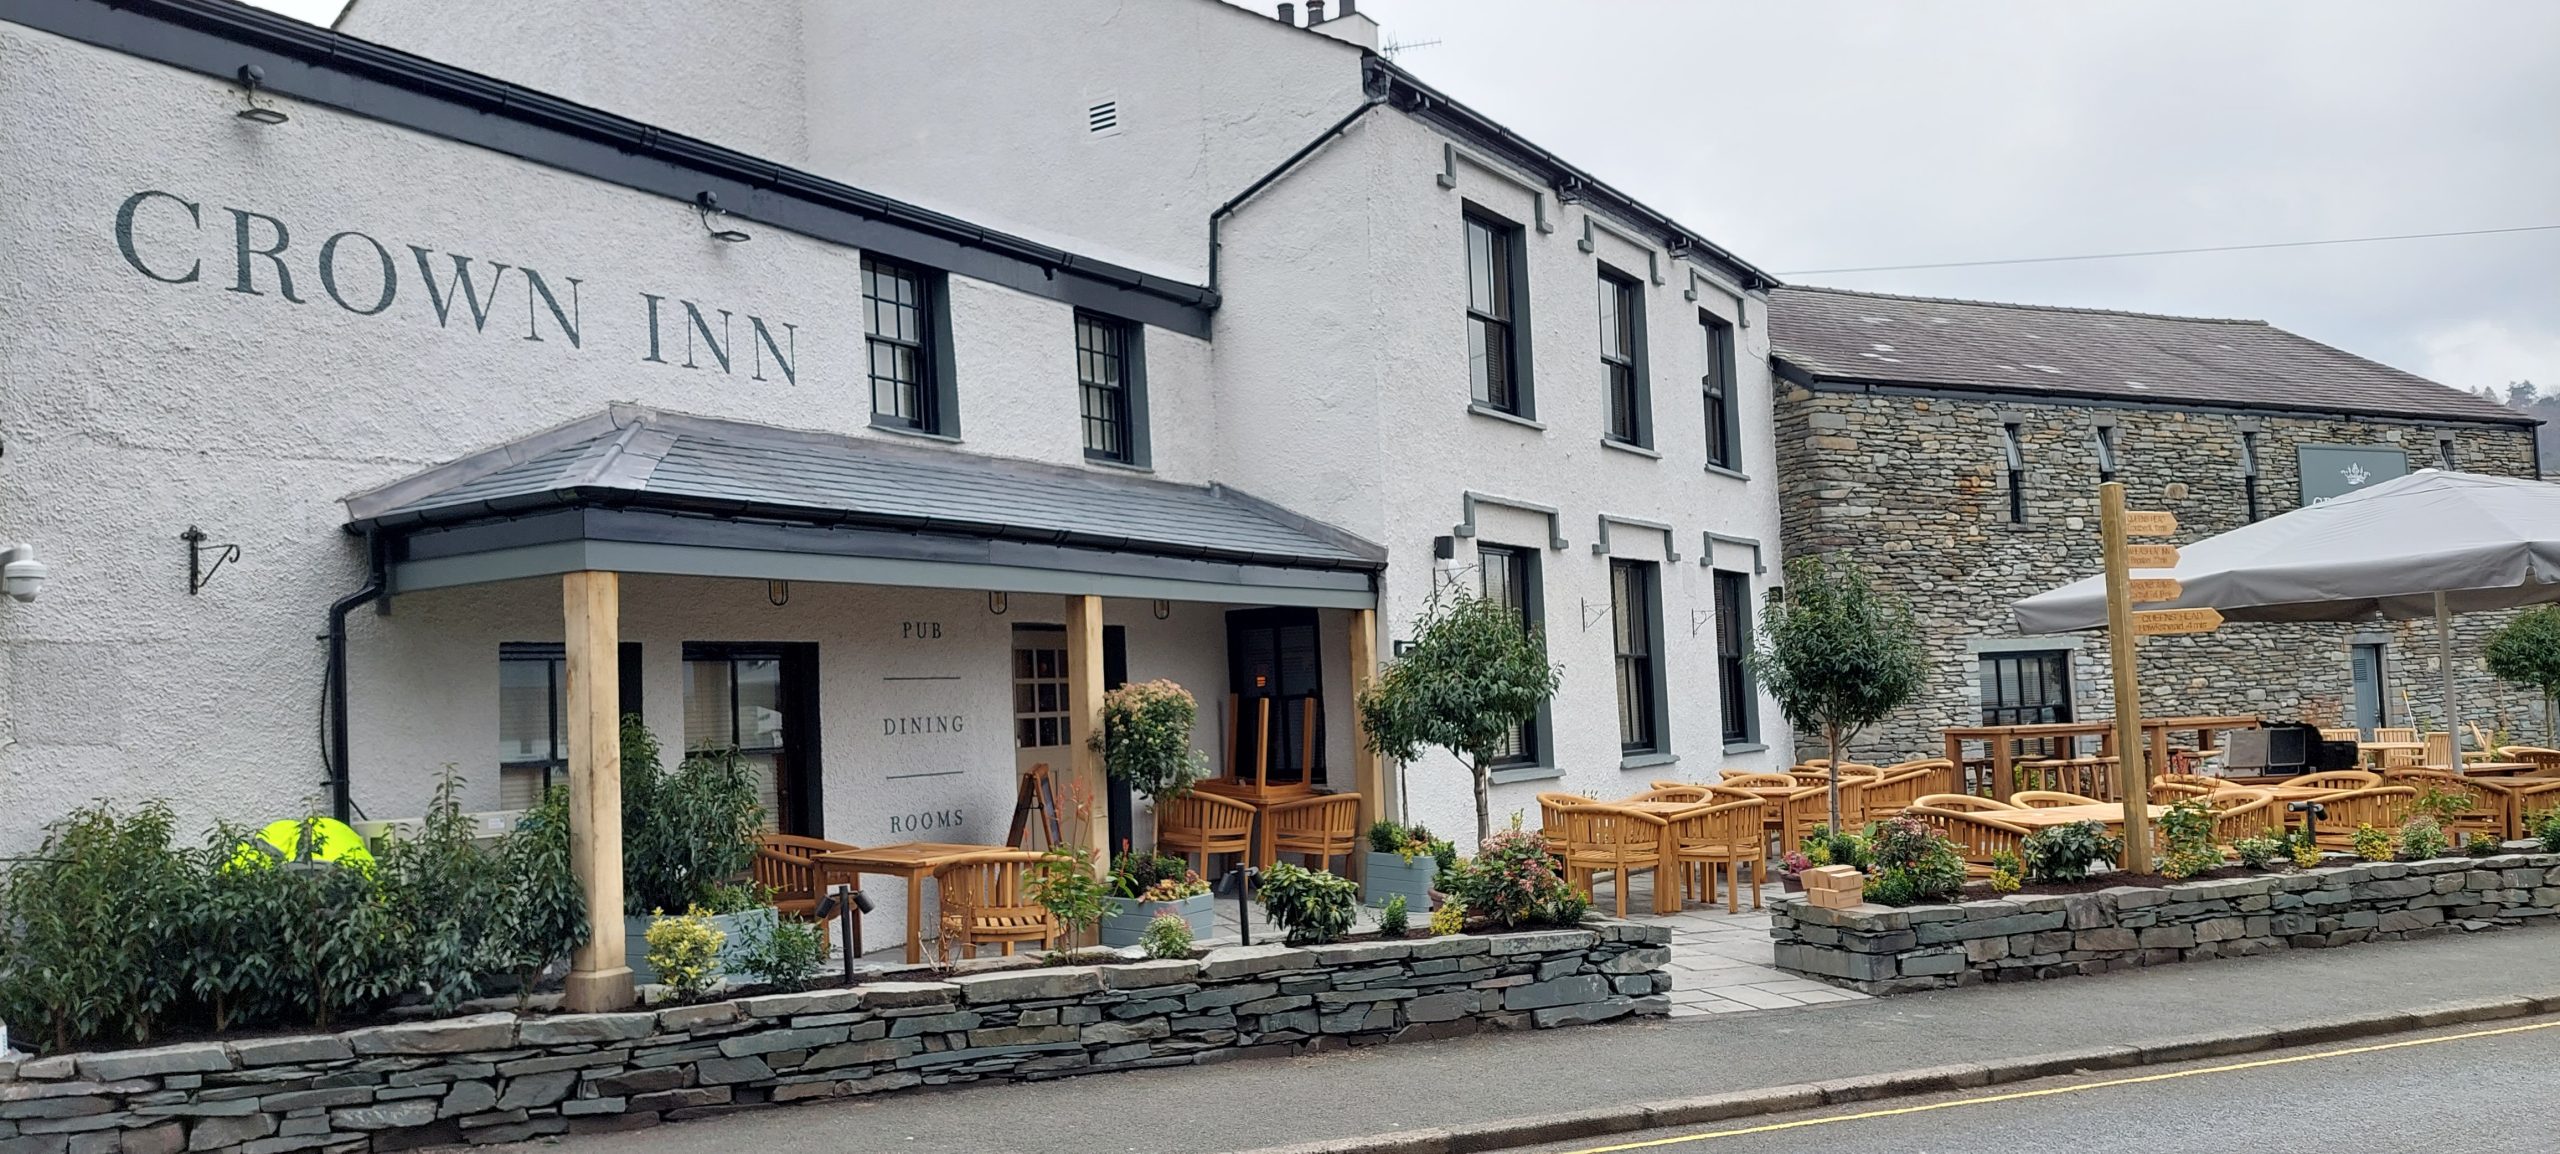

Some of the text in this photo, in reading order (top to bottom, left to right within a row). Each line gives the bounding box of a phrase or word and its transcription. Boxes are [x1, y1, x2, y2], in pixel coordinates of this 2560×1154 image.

[114, 189, 798, 386] CROWN INN
[2141, 611, 2204, 623] QUEENS HEAD
[903, 622, 942, 639] PUB
[883, 715, 964, 736] DINING
[890, 810, 963, 833] ROOMS
